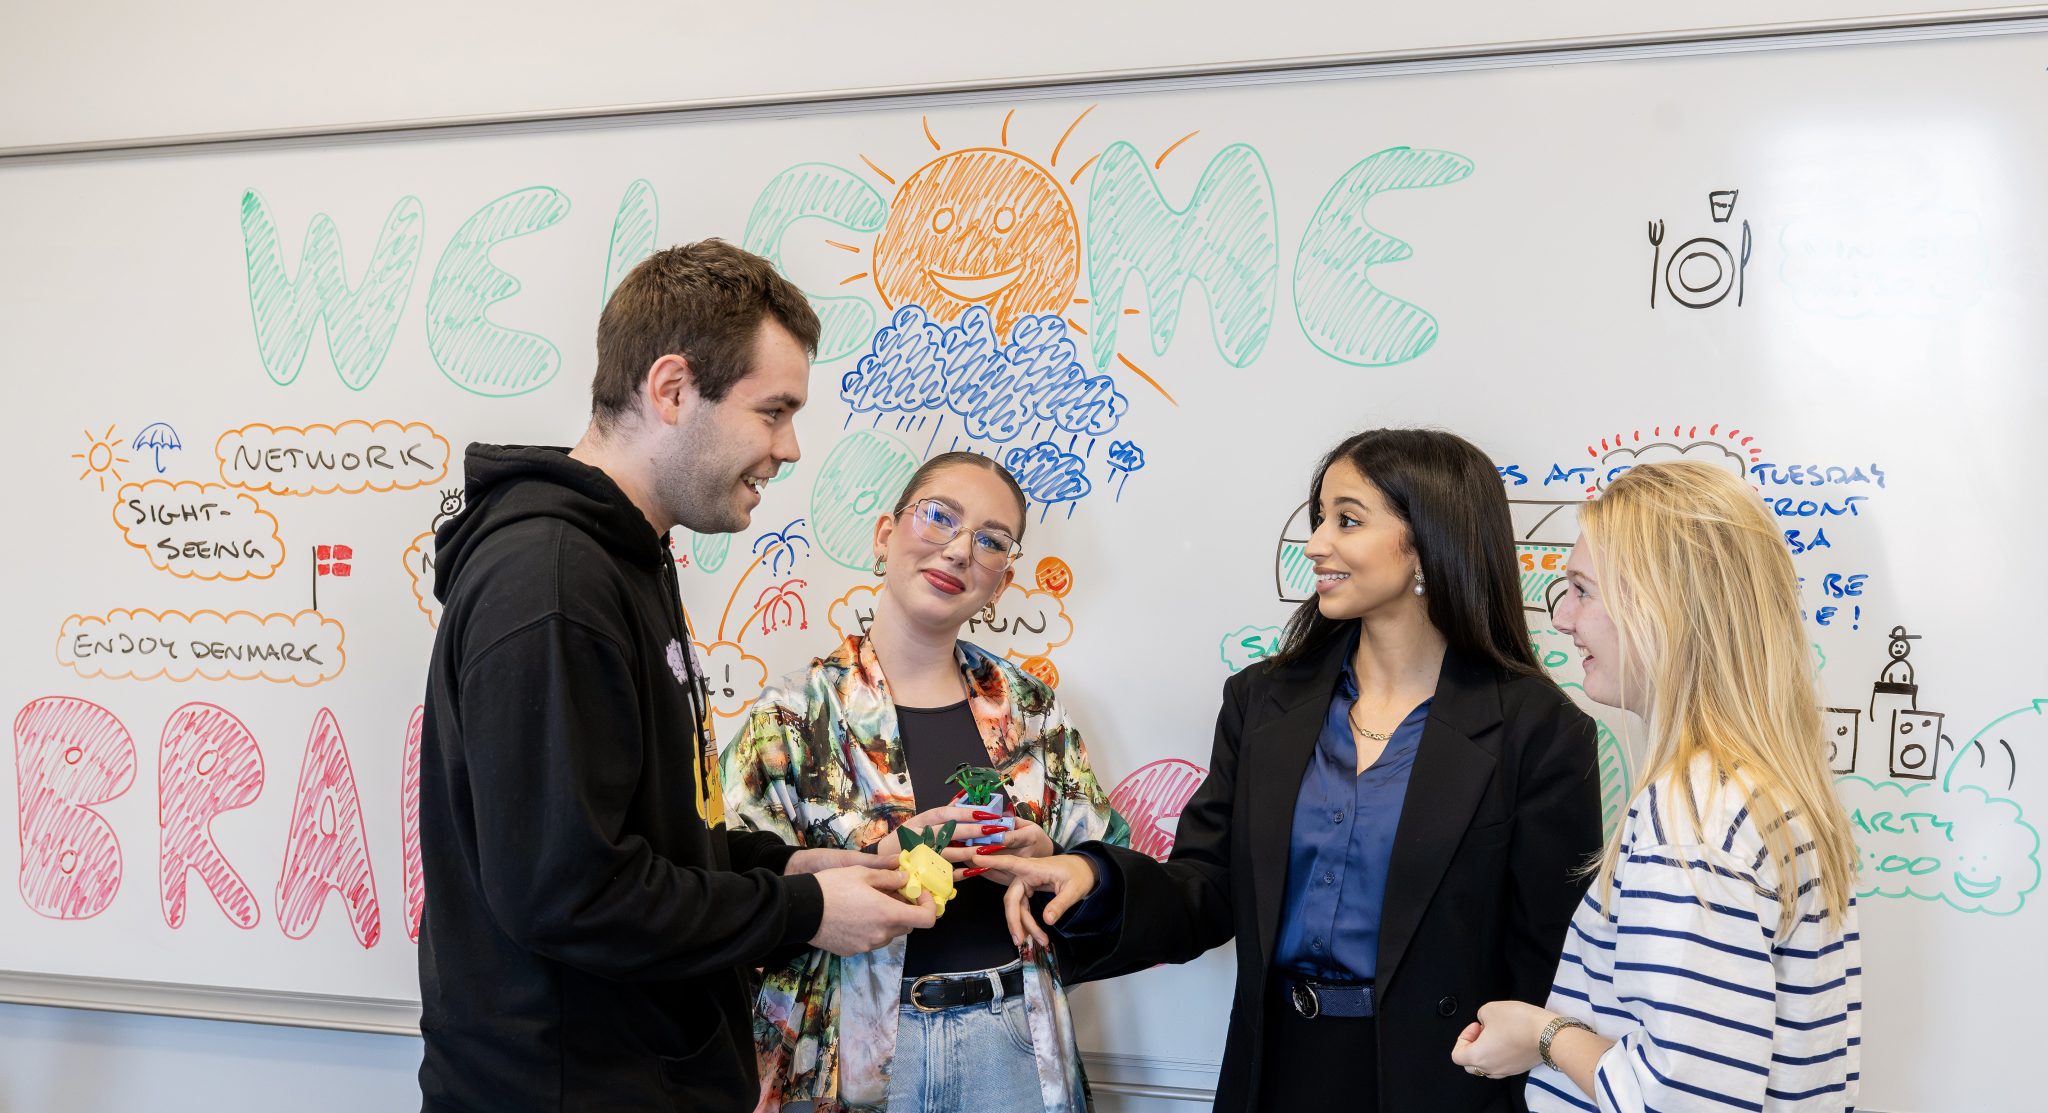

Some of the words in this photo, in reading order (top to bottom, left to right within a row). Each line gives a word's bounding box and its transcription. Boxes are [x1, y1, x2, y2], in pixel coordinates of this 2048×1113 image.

[234, 444, 434, 472] NETWORK
[1543, 463, 1595, 486] AT
[1750, 463, 1886, 489] TUESDAY
[129, 499, 231, 525] SIGHT-
[157, 537, 265, 560] SEEING
[1823, 573, 1869, 599] BE
[73, 634, 178, 659] ENJOY
[190, 641, 324, 665] DENMARK
[1850, 808, 1954, 842] ARTY
